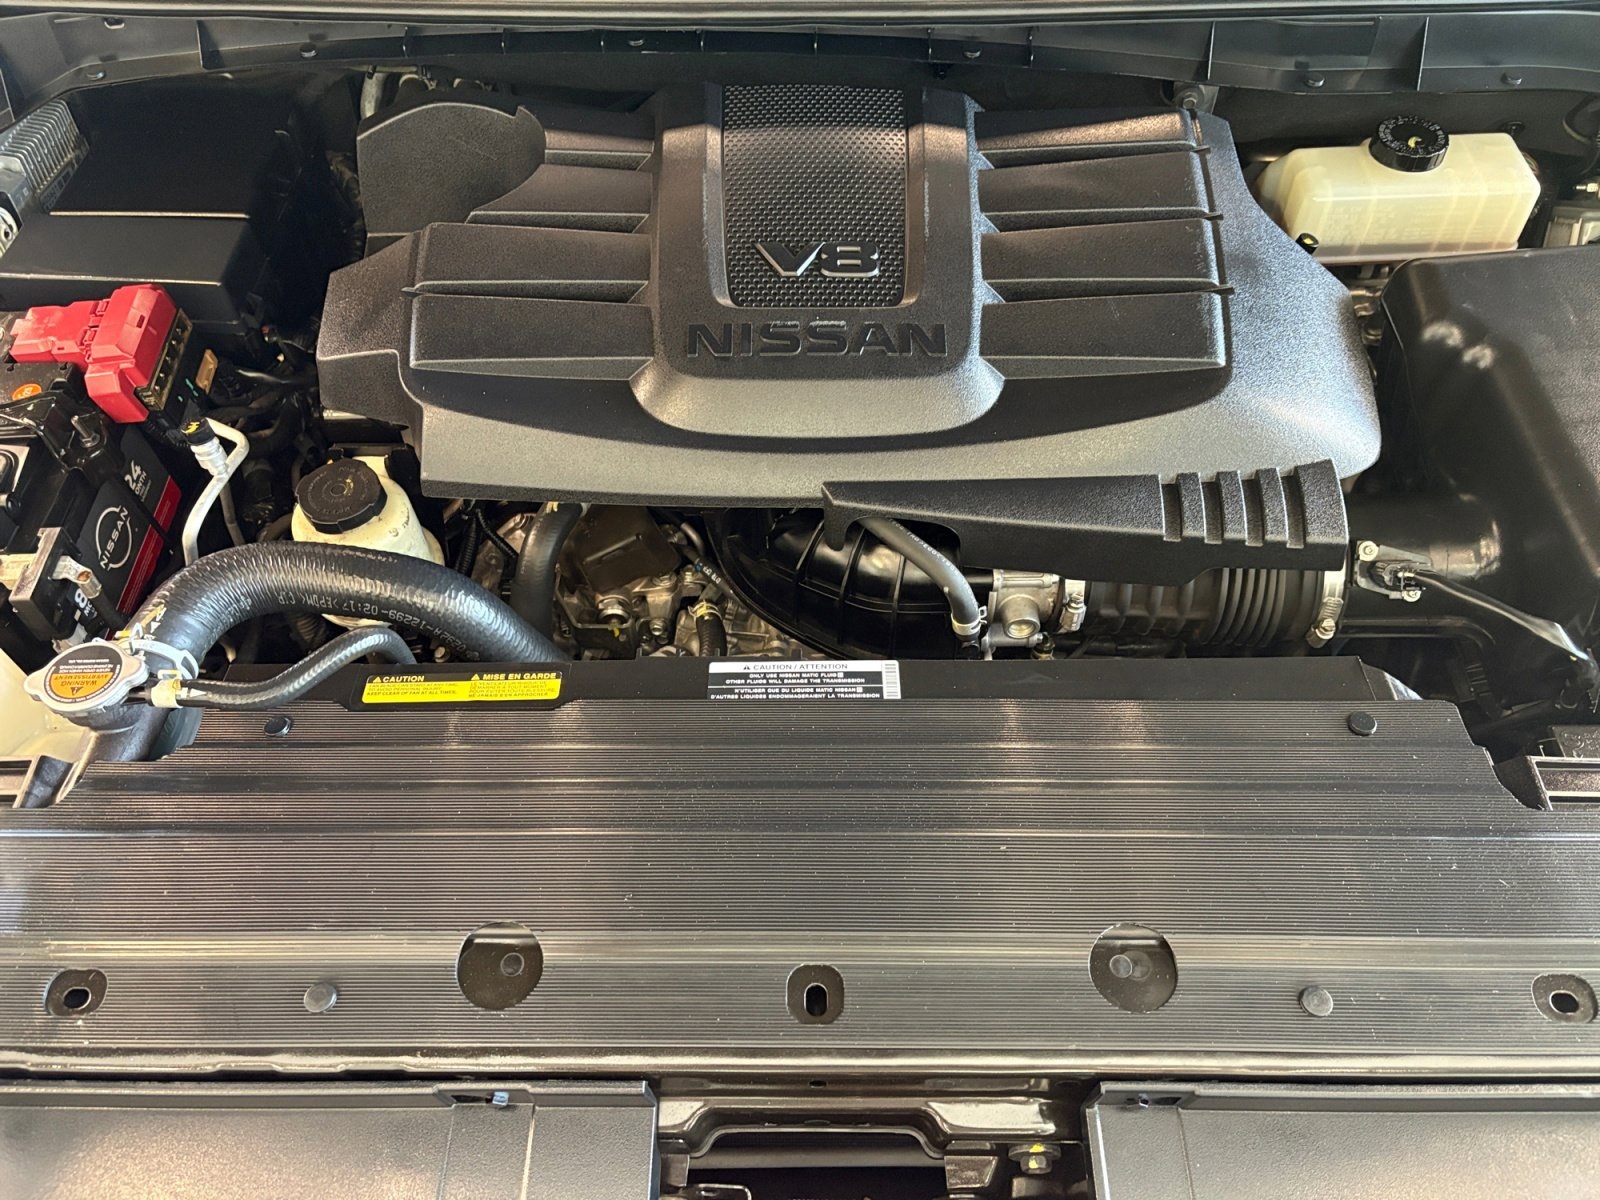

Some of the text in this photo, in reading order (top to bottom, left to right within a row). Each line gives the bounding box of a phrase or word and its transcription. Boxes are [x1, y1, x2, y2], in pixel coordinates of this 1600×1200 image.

[753, 241, 880, 277] V8
[687, 321, 948, 357] NISSAN
[124, 460, 142, 490] 24
[134, 470, 148, 496] ONTH
[100, 507, 129, 569] NISSAN
[382, 675, 425, 683] CAUTION
[523, 672, 557, 680] GARDE
